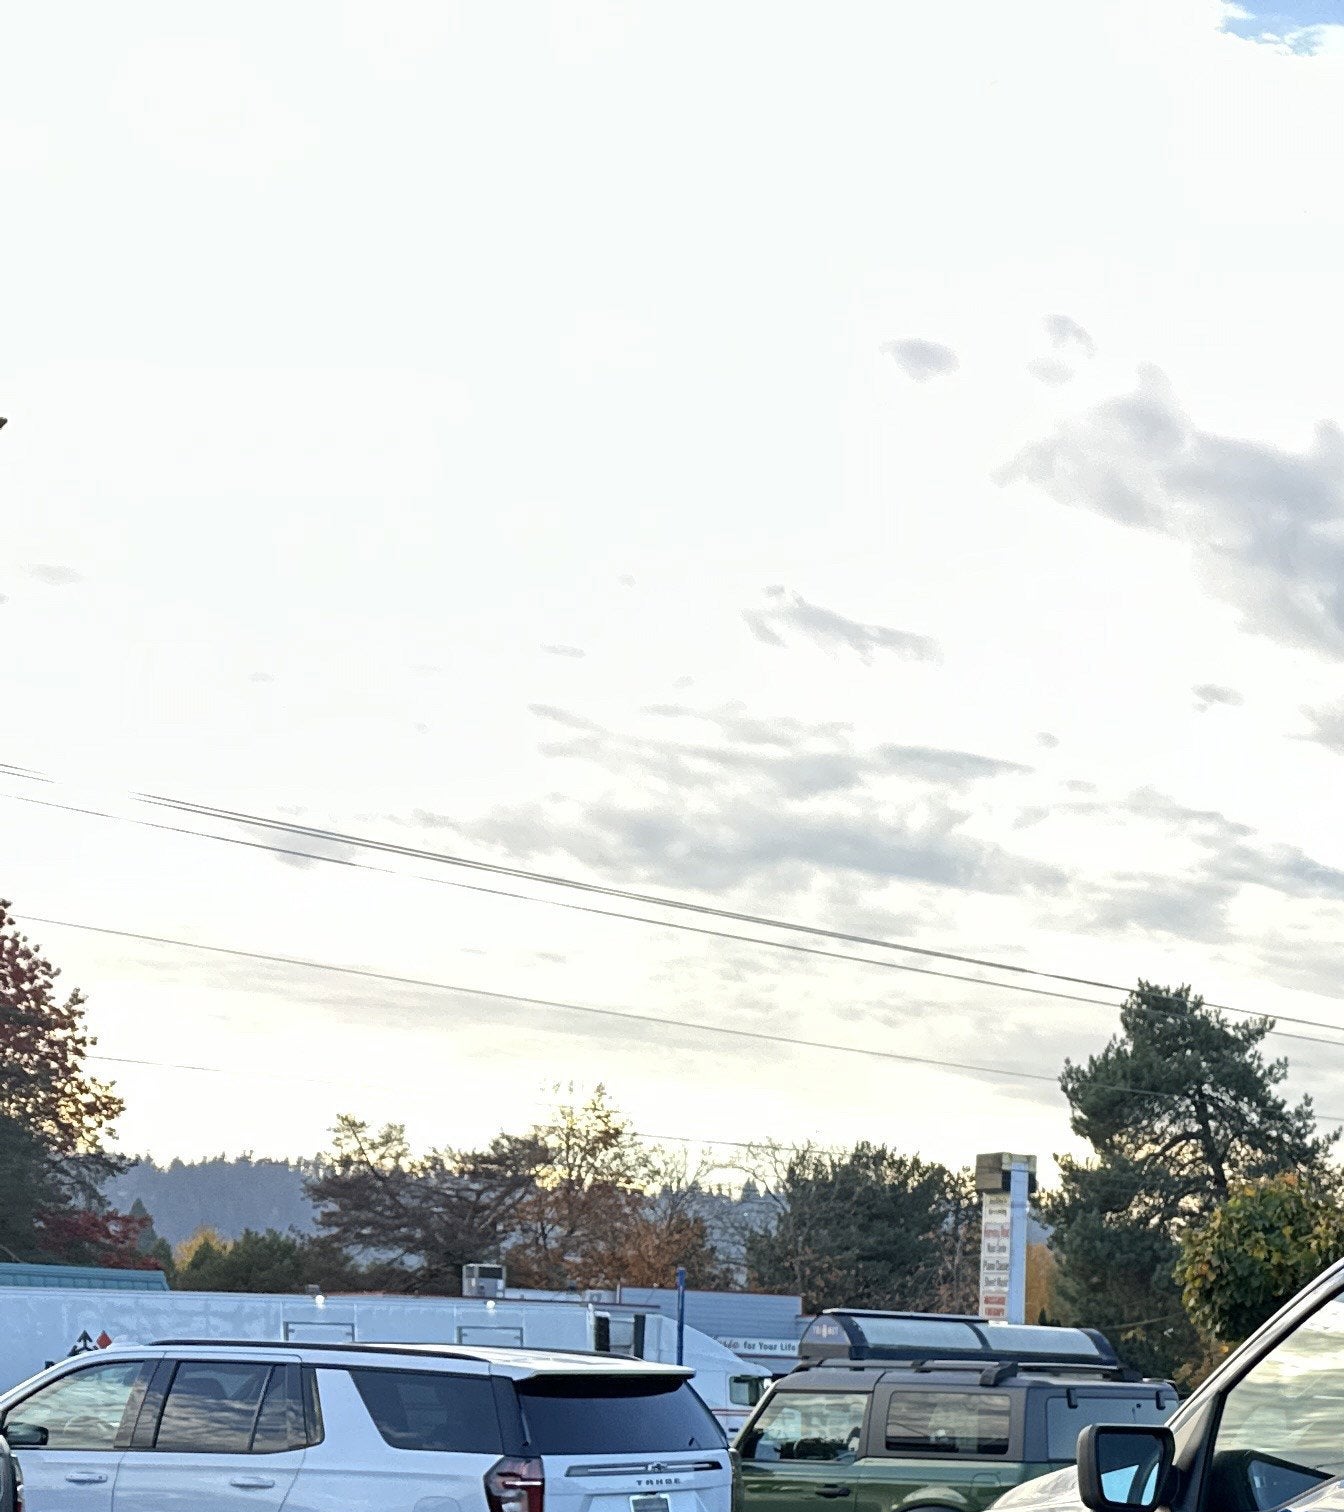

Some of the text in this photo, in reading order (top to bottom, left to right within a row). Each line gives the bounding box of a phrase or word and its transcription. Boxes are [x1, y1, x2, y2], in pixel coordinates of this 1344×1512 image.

[743, 1341, 756, 1349] for
[759, 1342, 778, 1351] Your
[780, 1342, 796, 1352] Life
[636, 1478, 681, 1486] TAHOE
